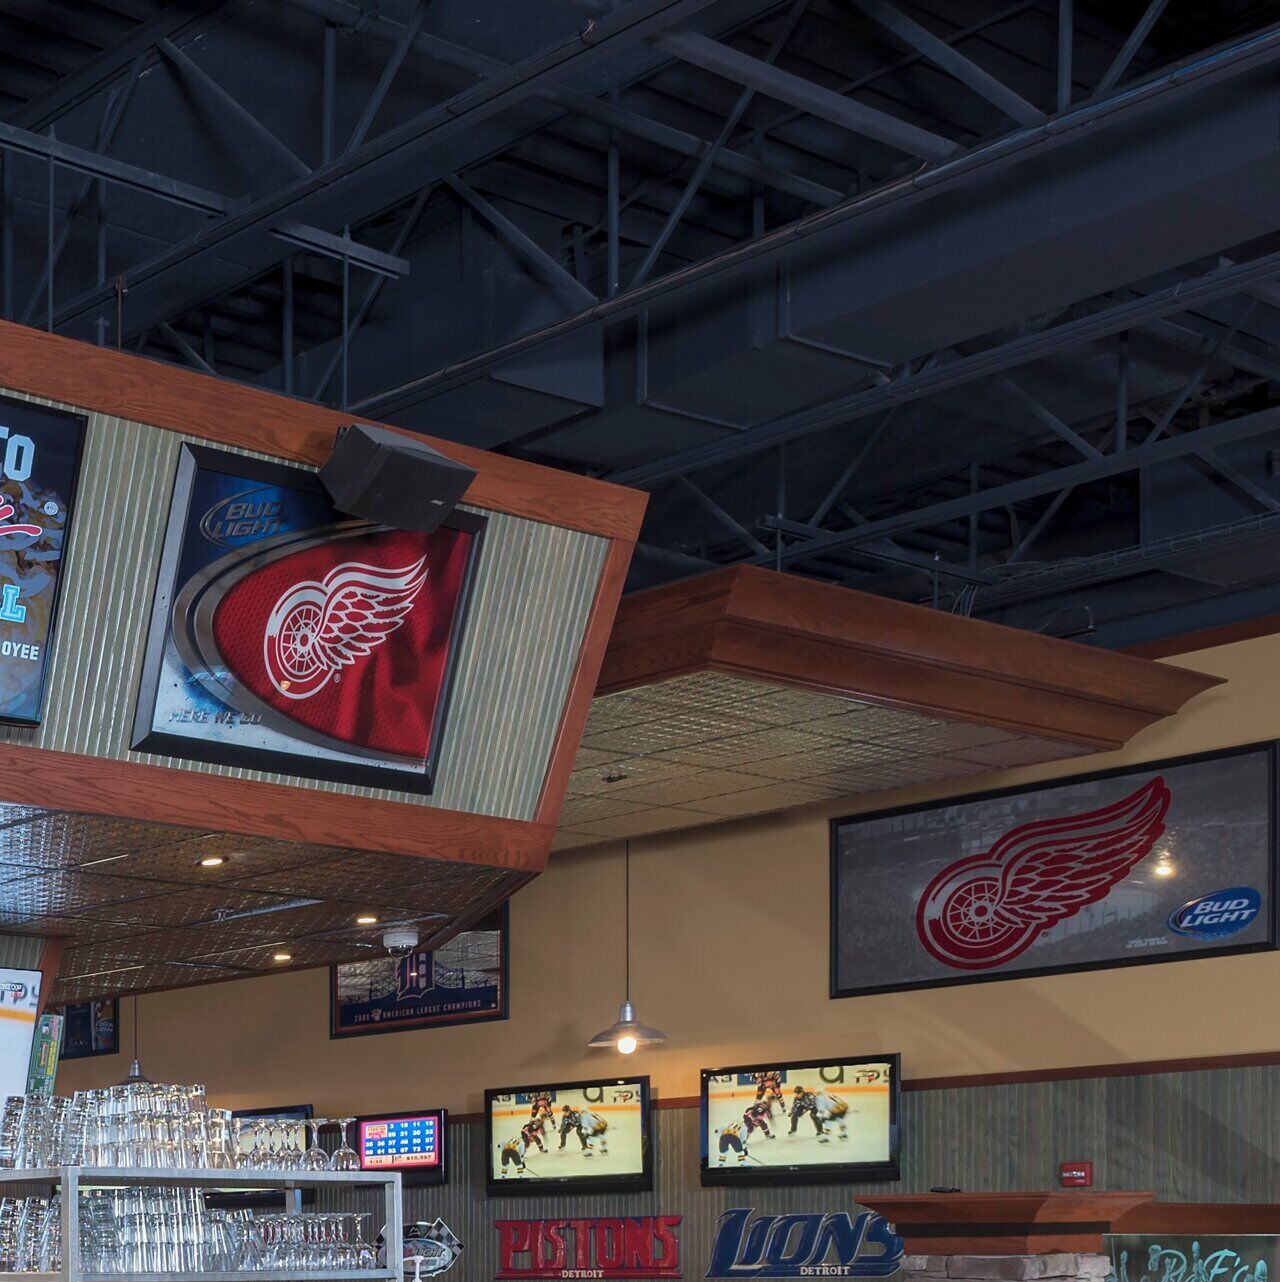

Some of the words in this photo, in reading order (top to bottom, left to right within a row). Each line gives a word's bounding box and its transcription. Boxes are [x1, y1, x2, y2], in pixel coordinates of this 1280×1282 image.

[1197, 898, 1250, 914] BUD
[1181, 907, 1256, 928] LIGHT
[383, 1008, 414, 1019] AMERICAN
[416, 1004, 440, 1015] LEAGUE
[443, 999, 482, 1011] CHAMPIONS
[494, 1214, 682, 1274] PISTONS
[704, 1208, 904, 1278] LIONS
[561, 1269, 605, 1280] DETROIT
[799, 1264, 850, 1278] DETROIT
